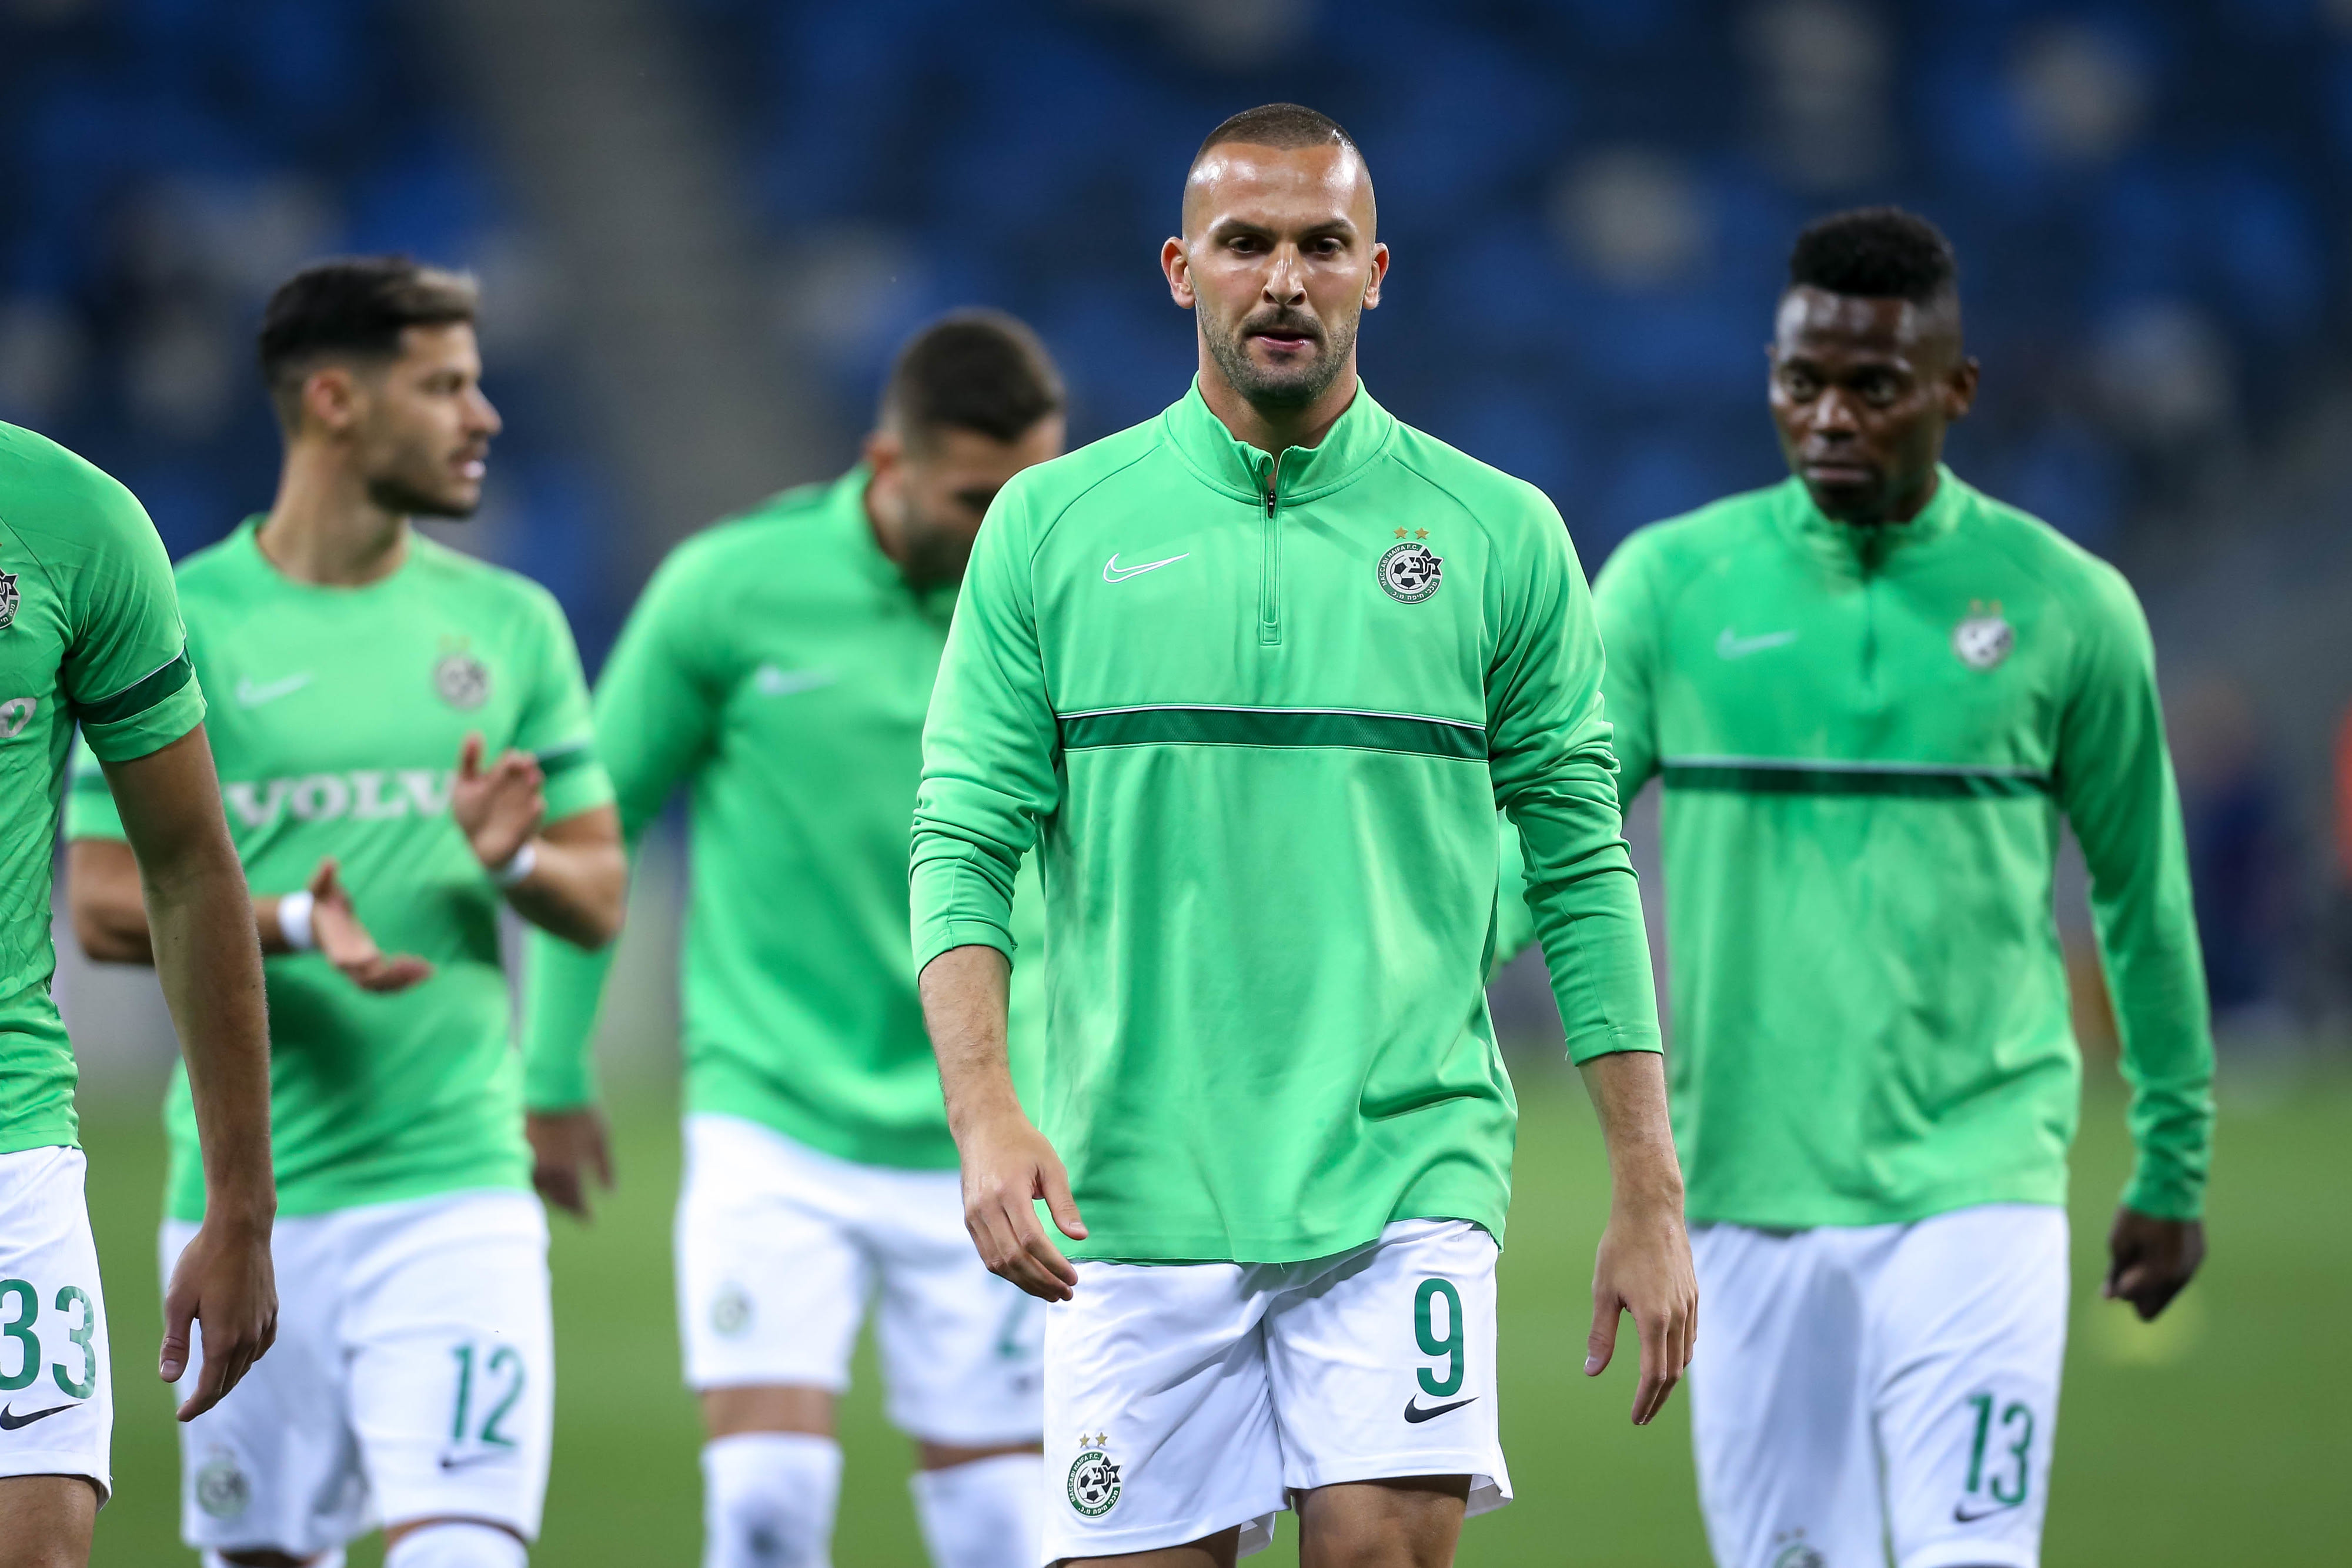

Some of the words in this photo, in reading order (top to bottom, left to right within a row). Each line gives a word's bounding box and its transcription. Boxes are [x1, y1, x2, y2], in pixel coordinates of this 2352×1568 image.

[1379, 557, 1389, 586] MACCABI
[1387, 546, 1406, 558] HAIFA
[1425, 581, 1438, 594] מכבי
[226, 770, 455, 826] VOLV
[0, 1279, 96, 1399] 33
[1414, 1278, 1464, 1397] 9
[449, 1343, 526, 1449] 12
[1073, 1455, 1088, 1470] HAIFA
[1965, 1392, 2034, 1507] 13
[1093, 1505, 1108, 1514] חיפה
[1108, 1490, 1118, 1505] מכבי
